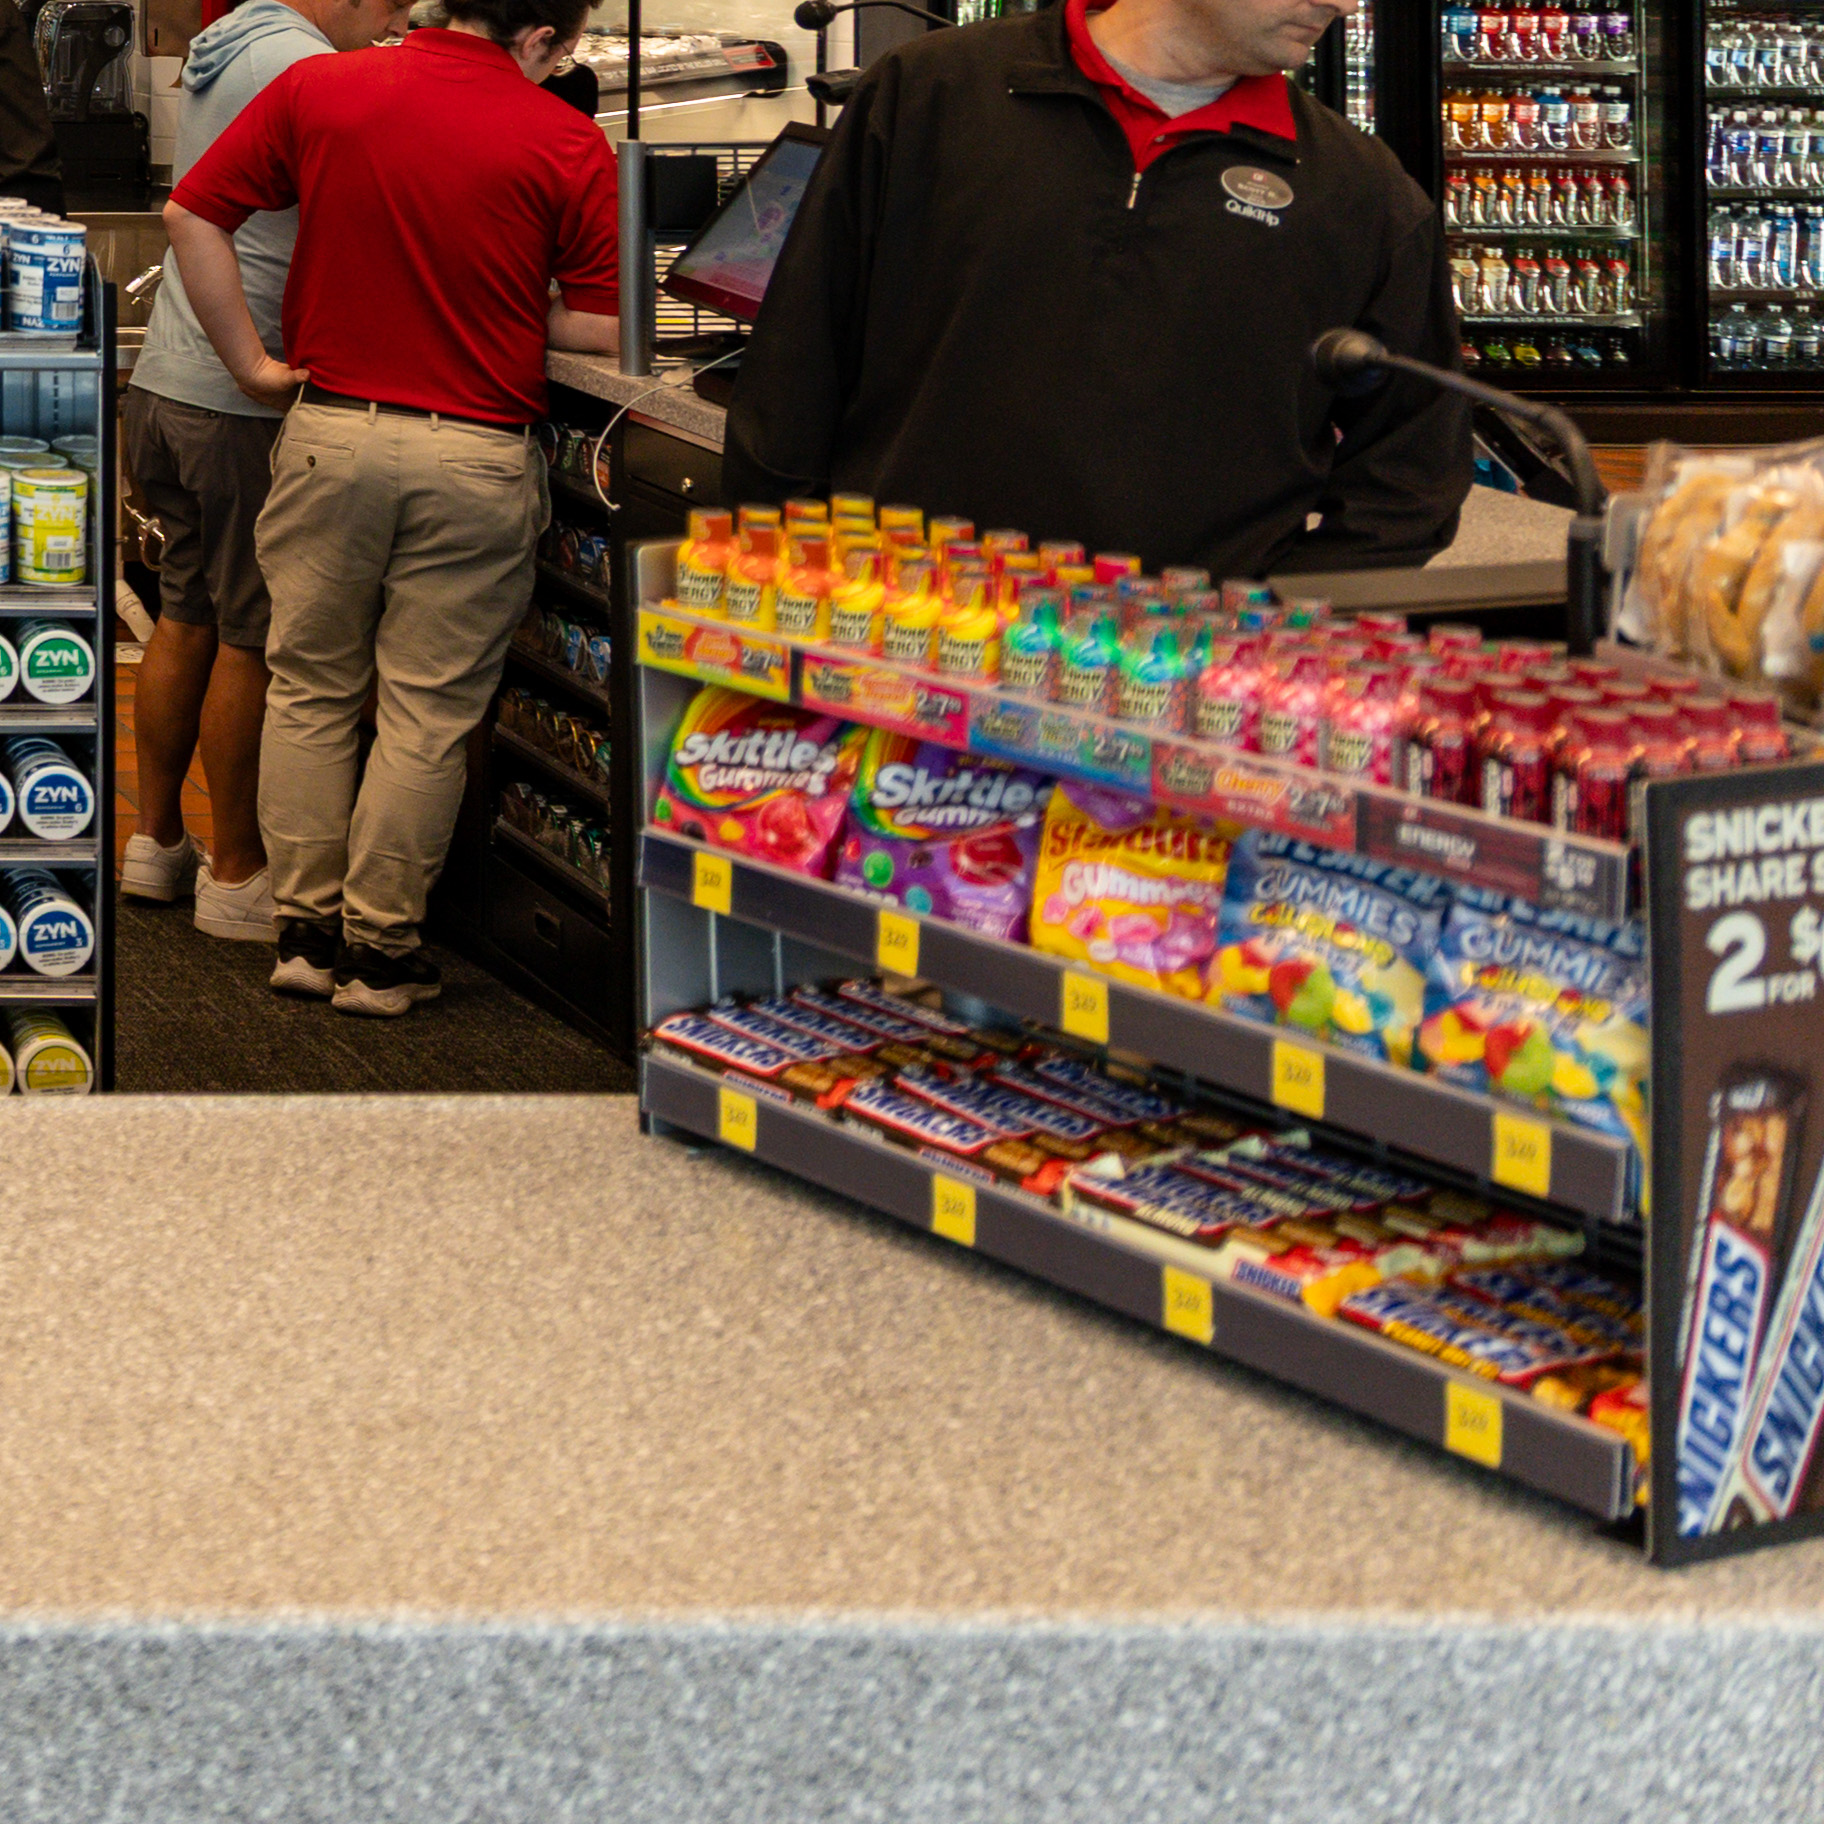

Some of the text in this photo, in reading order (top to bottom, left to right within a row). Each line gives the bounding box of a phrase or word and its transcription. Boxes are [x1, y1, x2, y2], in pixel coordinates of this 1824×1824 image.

[676, 730, 837, 772] Skittles
[1685, 796, 1824, 862] SNICKE
[1686, 854, 1808, 911] SHARE
[1706, 911, 1815, 1014] 2 FOR
